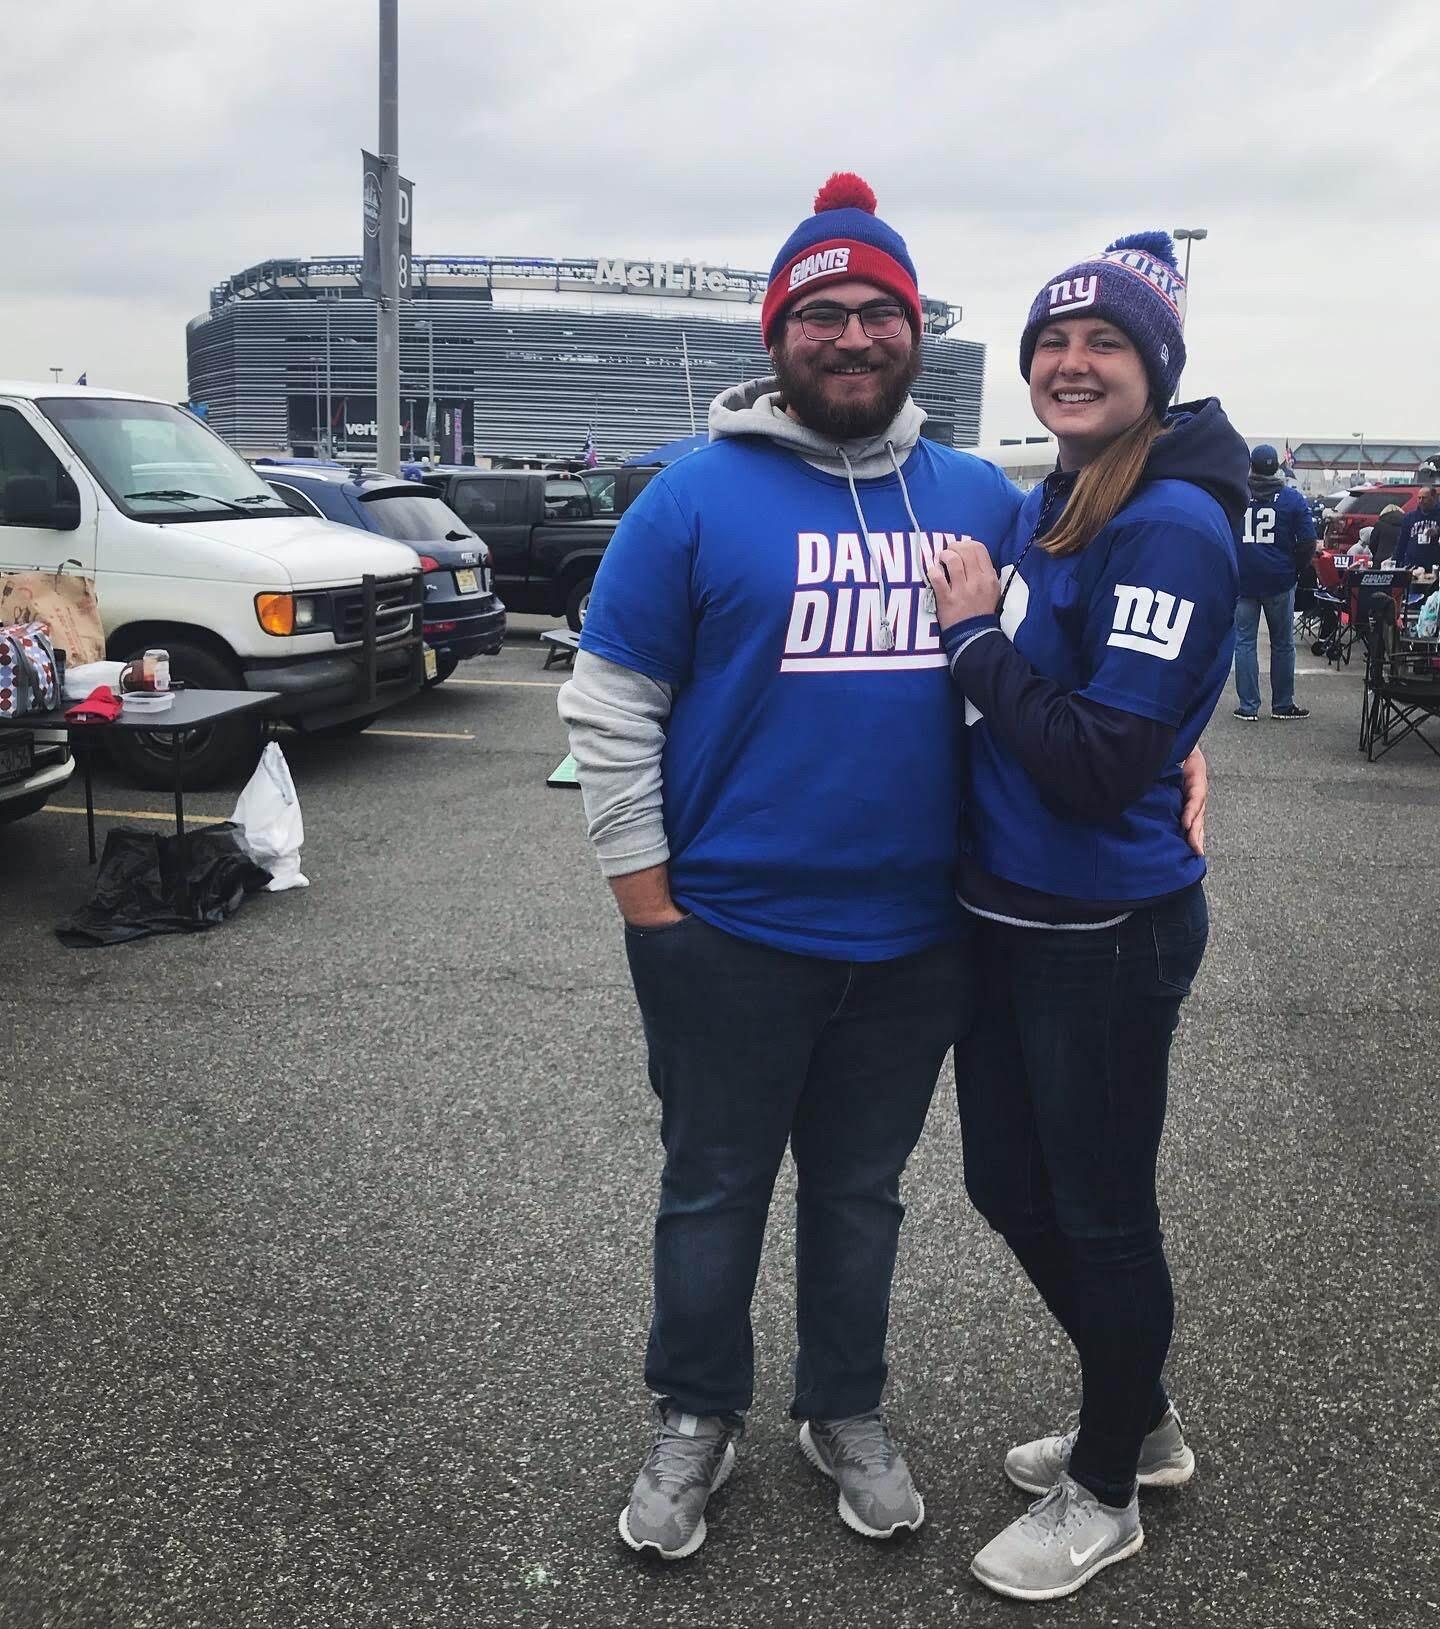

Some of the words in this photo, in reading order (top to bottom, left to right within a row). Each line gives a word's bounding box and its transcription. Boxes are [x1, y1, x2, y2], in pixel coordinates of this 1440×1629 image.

[593, 257, 729, 292] MetLife
[789, 247, 851, 286] GIANTS
[345, 420, 404, 437] veri
[1242, 507, 1276, 543] 12
[797, 531, 972, 585] DANN
[1360, 574, 1394, 584] GIANTS
[784, 587, 940, 654] DIME
